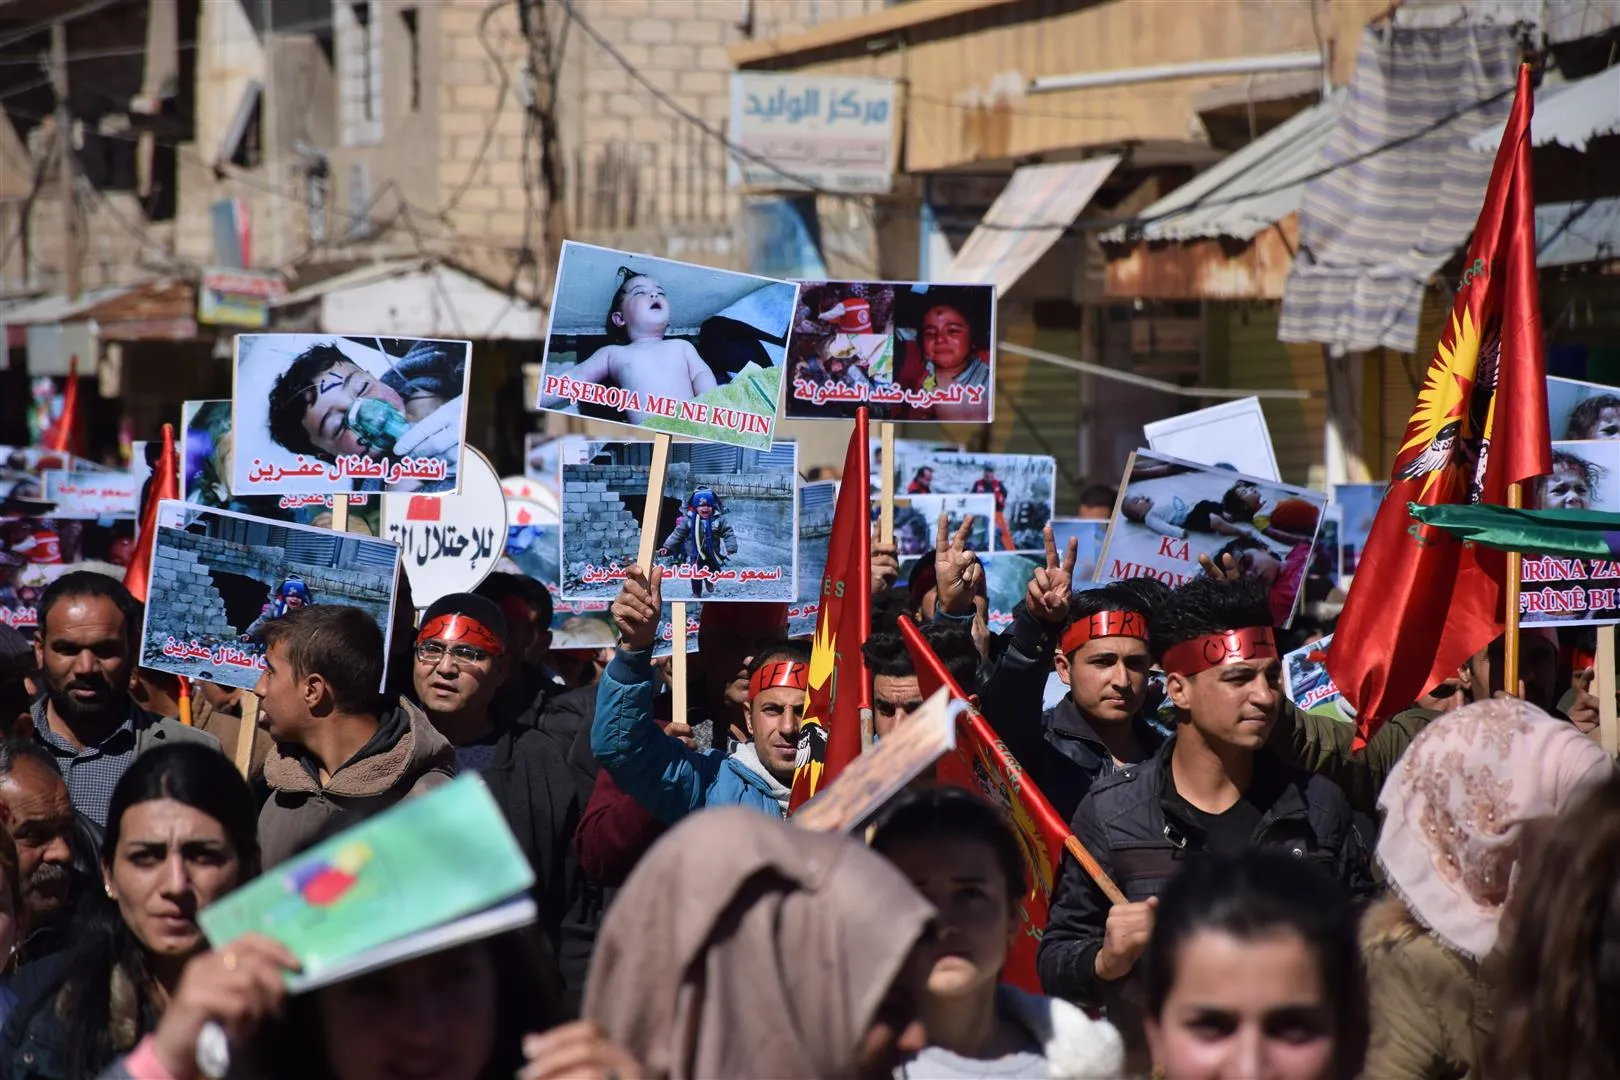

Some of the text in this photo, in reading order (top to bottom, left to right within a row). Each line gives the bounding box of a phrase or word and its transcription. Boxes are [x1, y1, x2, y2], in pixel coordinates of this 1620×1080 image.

[743, 87, 889, 127] مركز الوليد
[545, 376, 772, 435] PÊŞEROJA ME NE KUJIN
[794, 380, 984, 408] لا للحرب ضد الطفولة
[249, 456, 324, 482] عفرين
[1157, 536, 1190, 562] KA
[679, 563, 736, 583] صرخات
[738, 565, 781, 583] اسمعو
[1588, 589, 1615, 610] BI
[163, 636, 212, 661] عفرين
[213, 645, 257, 669] اطفال
